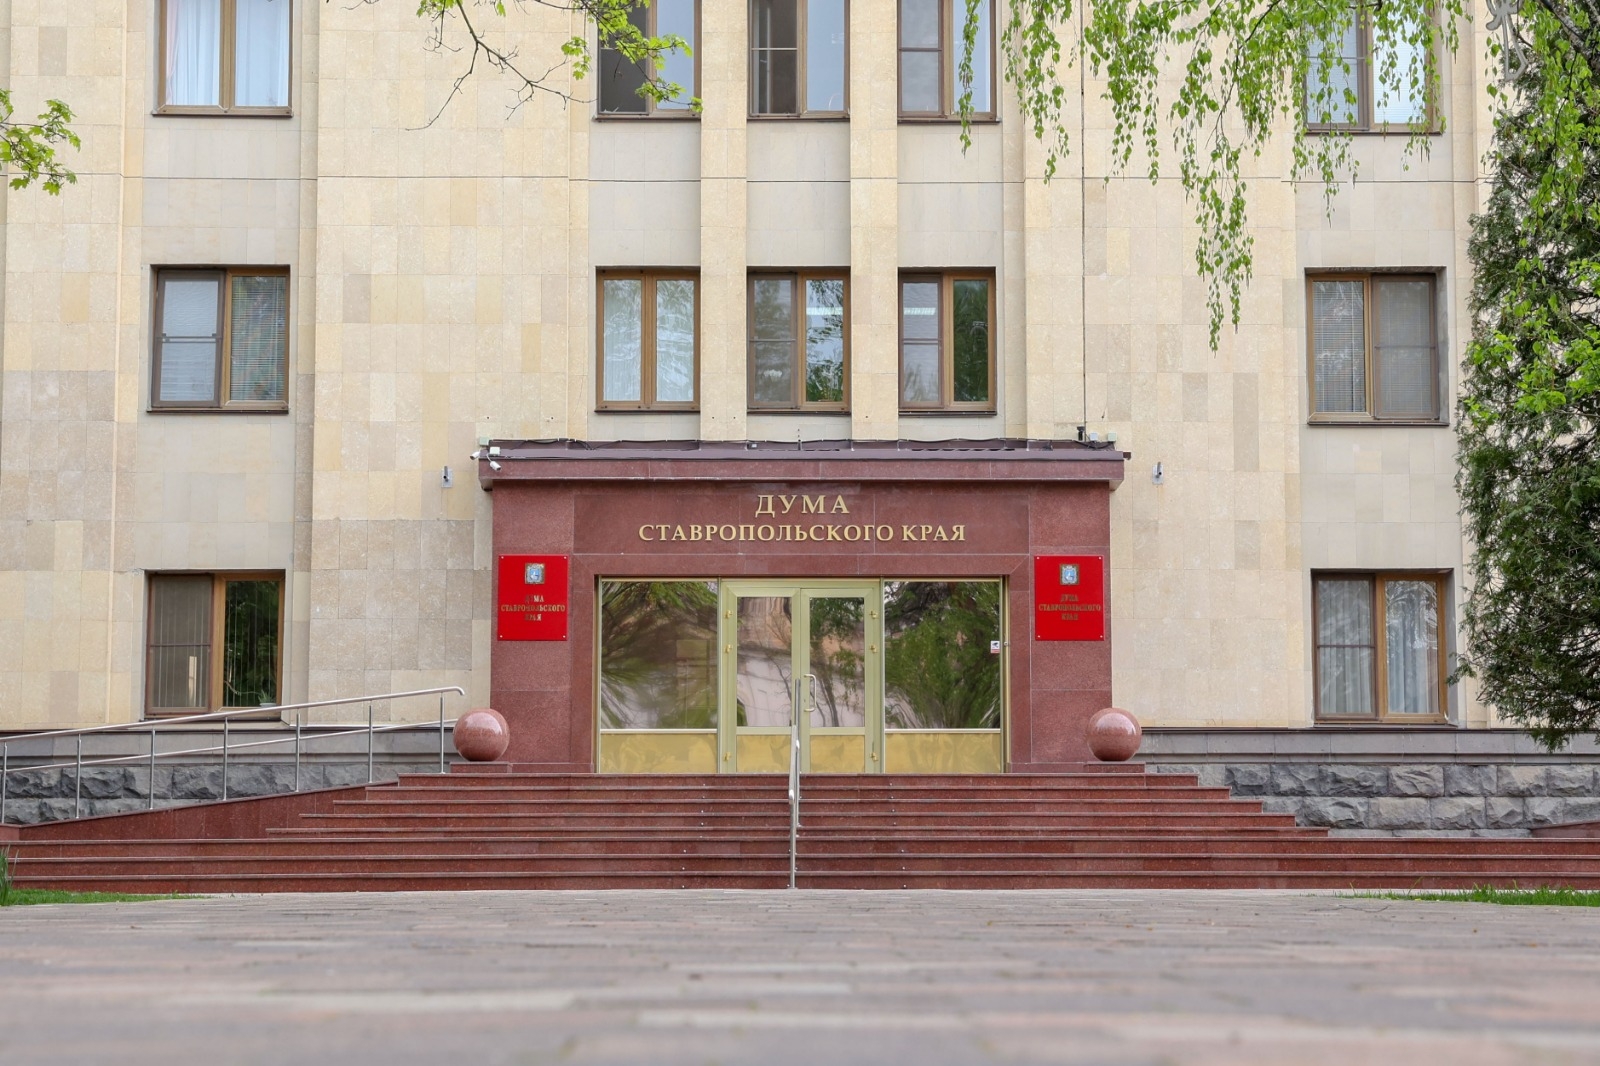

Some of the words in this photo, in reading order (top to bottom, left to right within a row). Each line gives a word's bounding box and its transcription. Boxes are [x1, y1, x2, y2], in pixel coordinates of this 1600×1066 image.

[755, 494, 850, 517] ДУМА
[638, 524, 894, 541] СТАВРОПОЛЬСКОГО
[901, 524, 966, 541] КРАЯ
